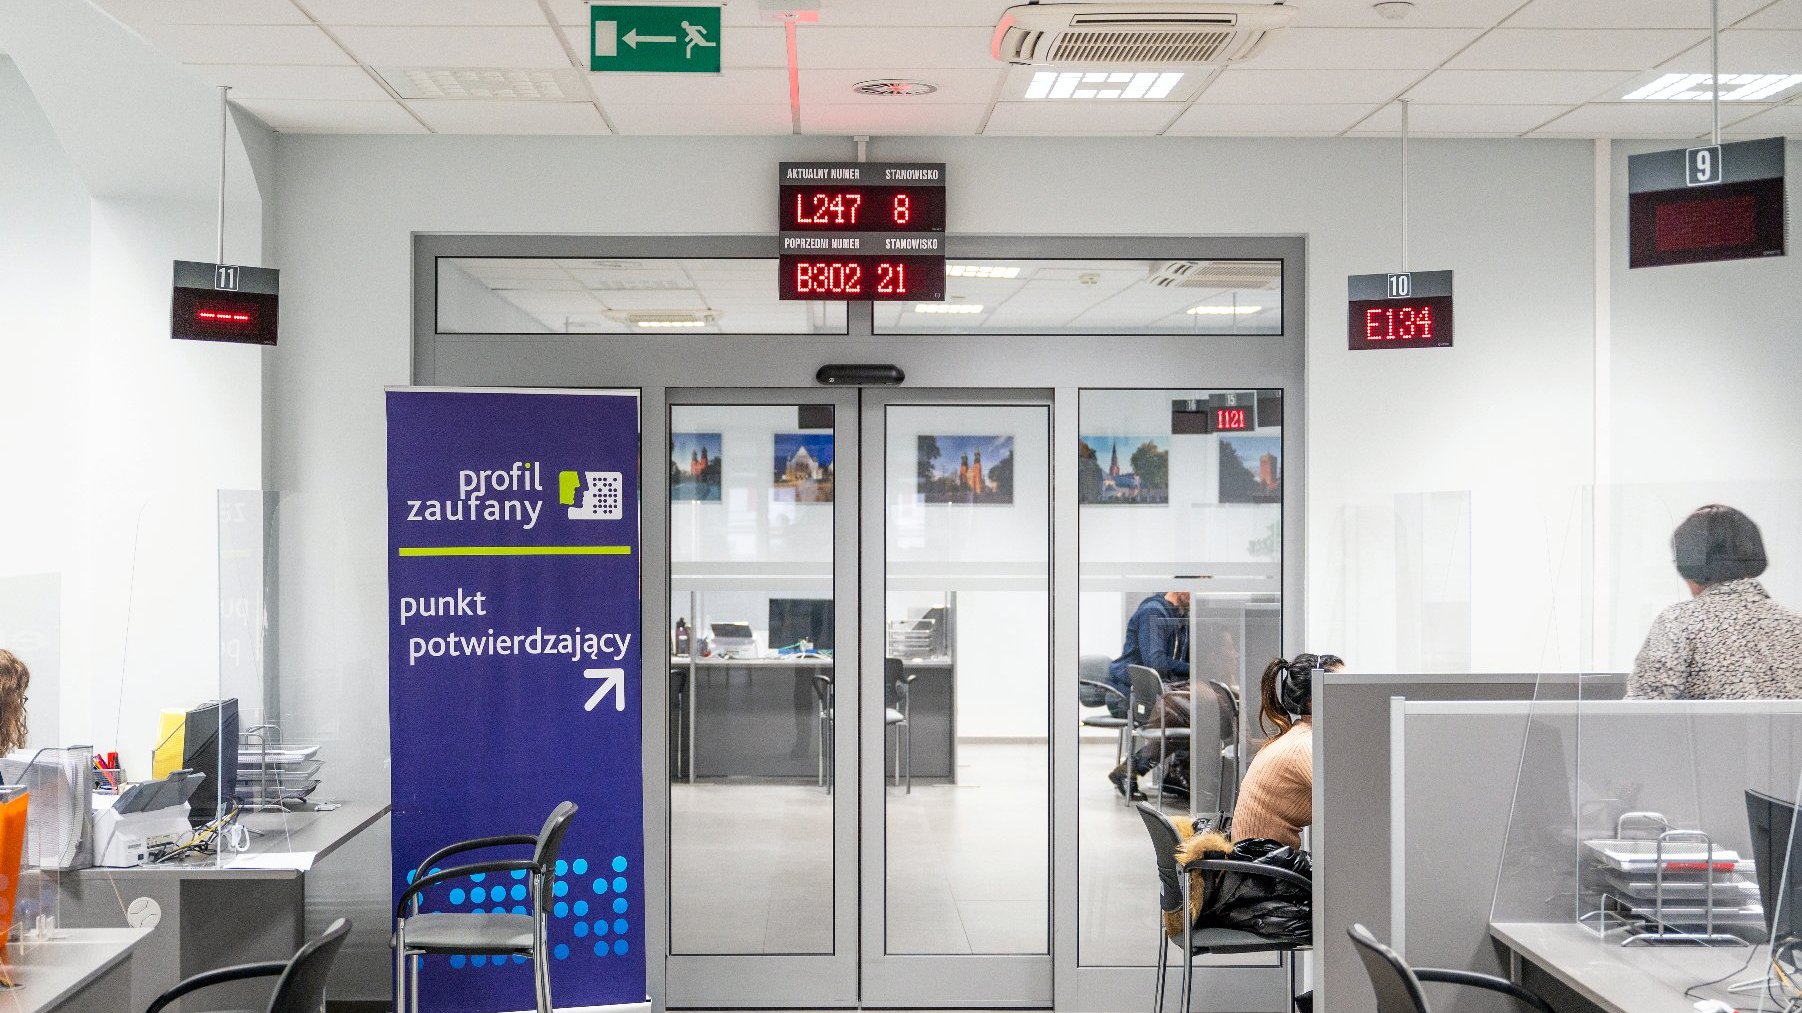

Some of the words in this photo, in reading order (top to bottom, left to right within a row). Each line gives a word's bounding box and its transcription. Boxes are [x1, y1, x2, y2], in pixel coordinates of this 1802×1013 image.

[787, 169, 829, 180] AKTUALNY
[831, 169, 860, 180] NUMER
[885, 169, 939, 180] STANOWISKO
[1696, 150, 1711, 181] 9
[797, 193, 861, 224] L247
[894, 194, 909, 224] 8
[784, 238, 829, 249] POPRZEDNI
[831, 238, 860, 249] NUMER
[885, 239, 938, 250] STANOWISKO
[218, 267, 234, 289] 11
[797, 263, 861, 293] B302
[877, 263, 906, 293] 21
[1390, 275, 1408, 296] 10
[1367, 306, 1432, 340] E134
[459, 461, 543, 500] profil
[406, 491, 543, 530] zaufany
[400, 587, 487, 626] punkt
[409, 626, 632, 666] potwierdzający
